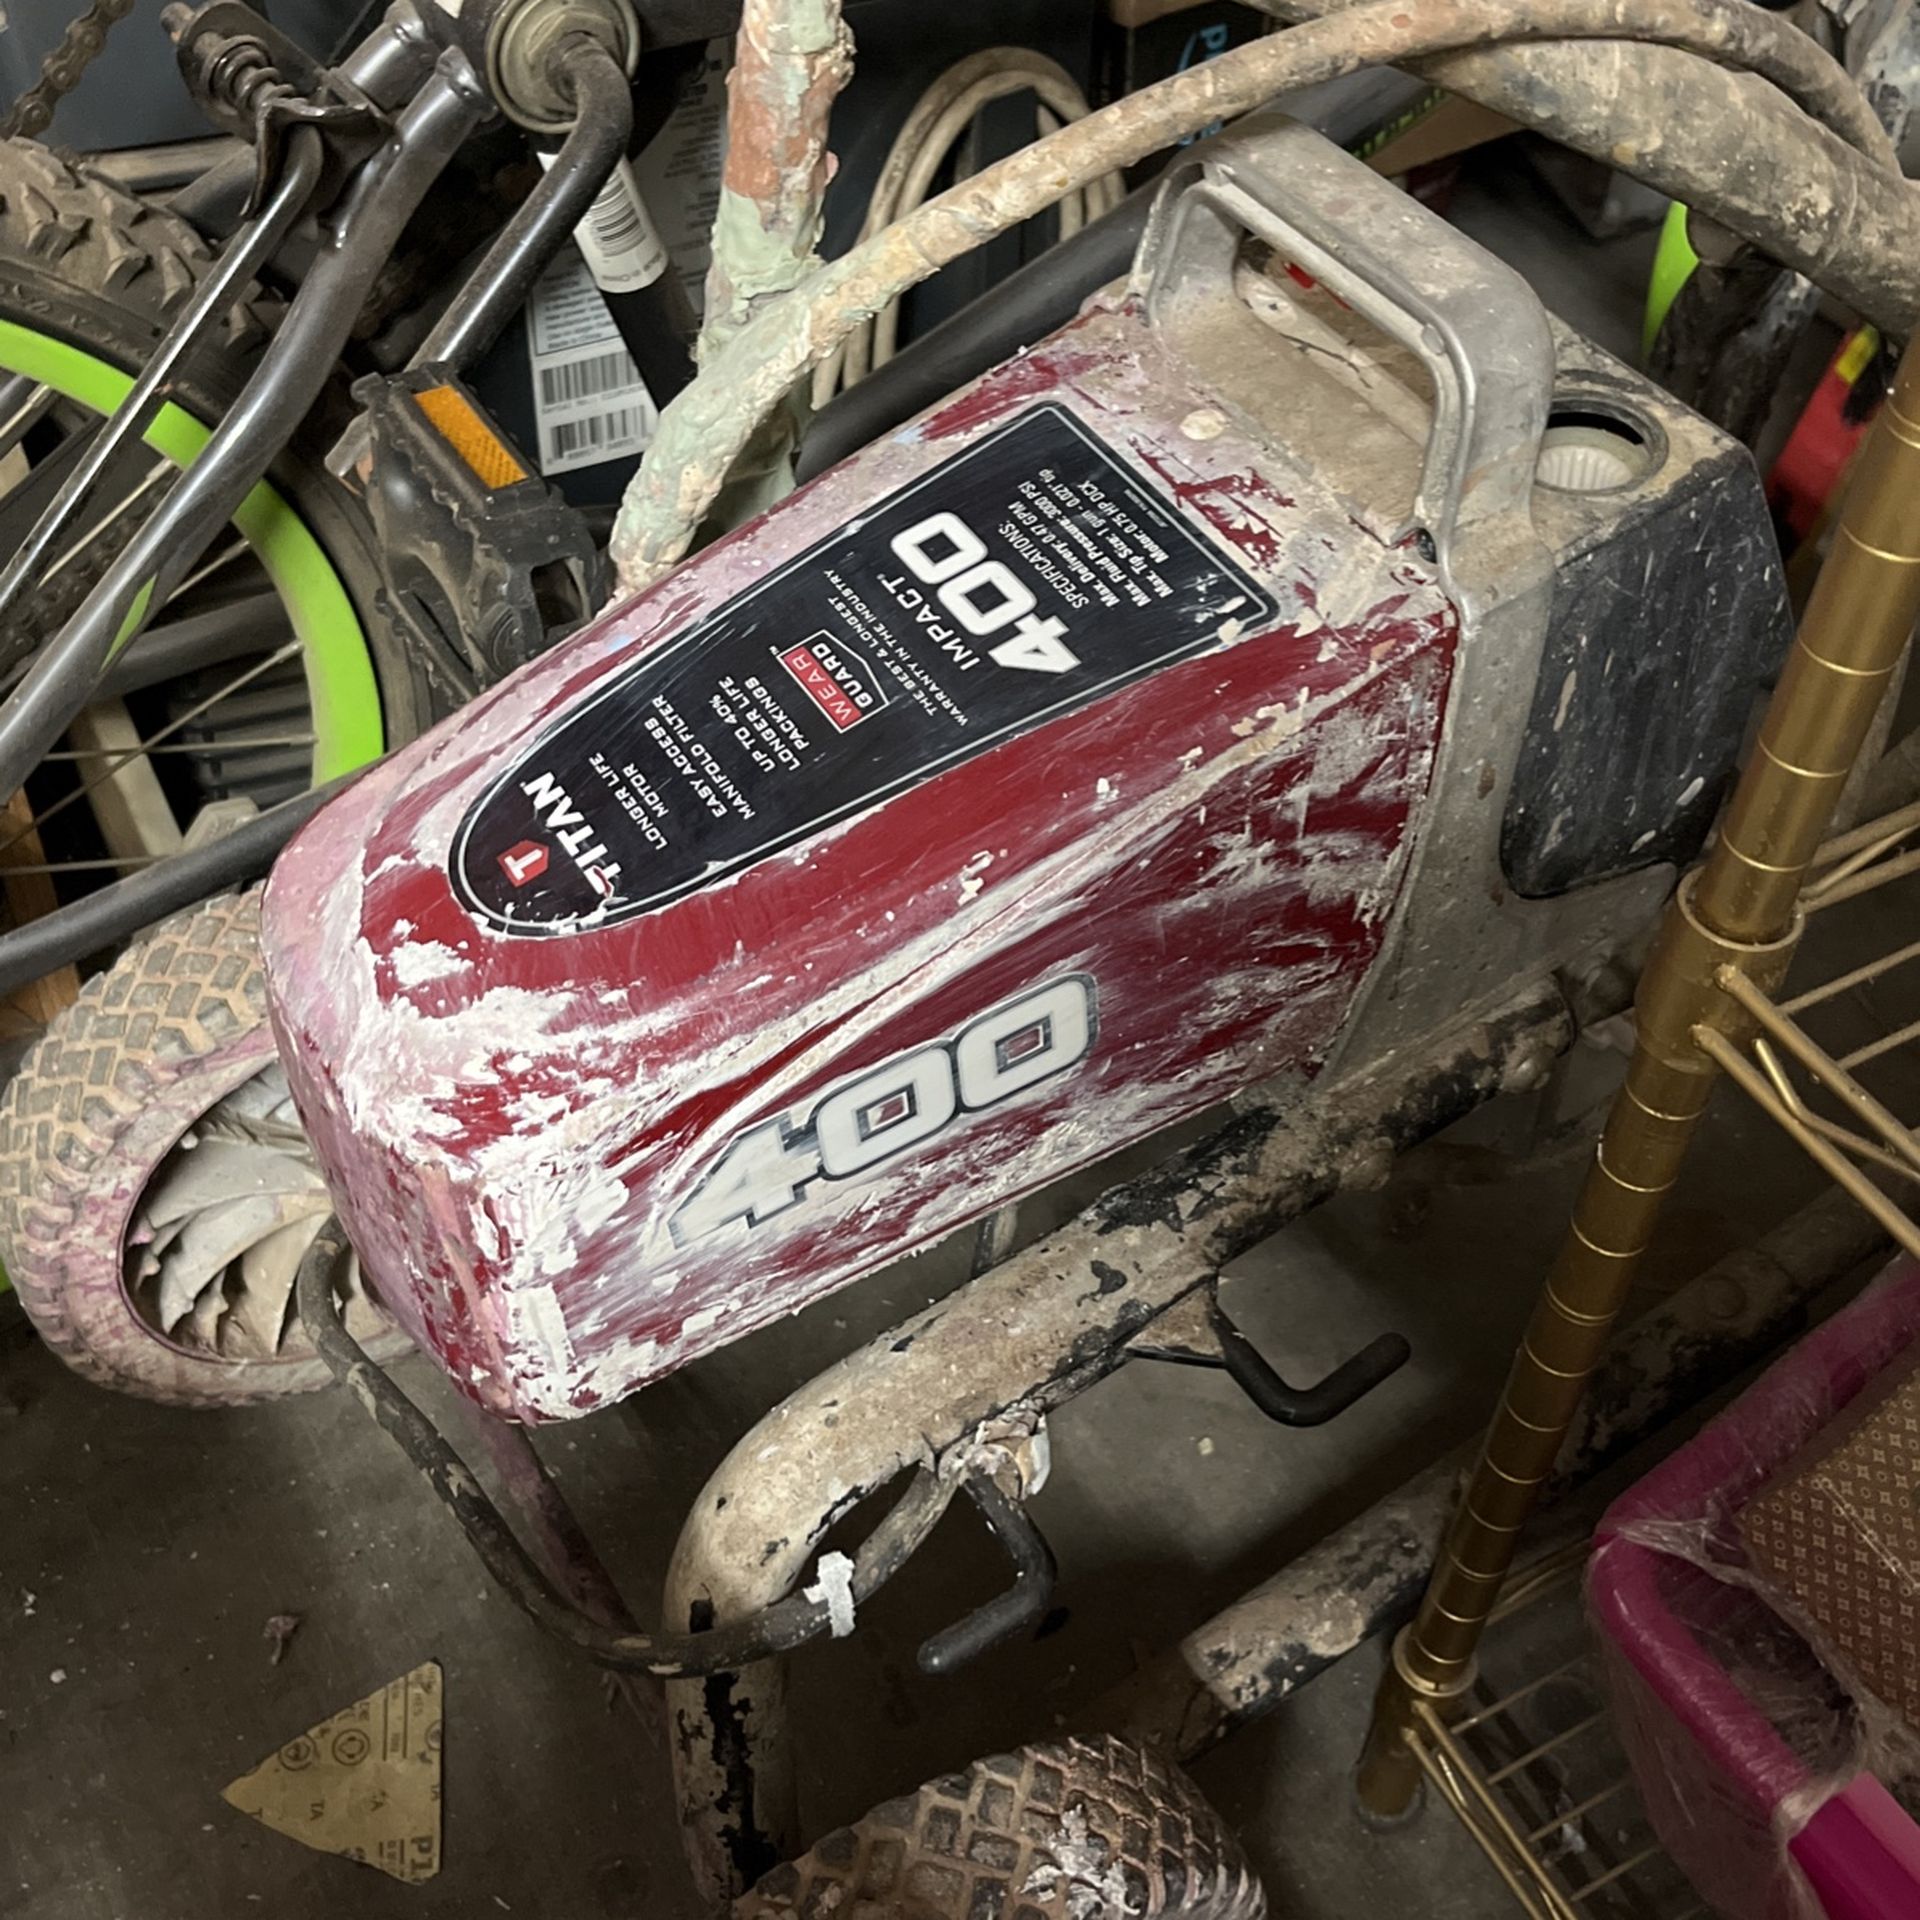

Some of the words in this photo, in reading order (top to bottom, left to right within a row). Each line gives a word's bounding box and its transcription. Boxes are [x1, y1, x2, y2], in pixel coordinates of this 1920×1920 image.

[1017, 480, 1042, 500] PSI
[1077, 480, 1106, 503] DCX
[1007, 501, 1038, 526] GPM
[1078, 509, 1107, 529] gun
[1097, 501, 1120, 516] HP
[1111, 512, 1138, 534] 0.75
[1030, 523, 1057, 544] 0.47
[1056, 515, 1104, 560] Pressure:
[1105, 533, 1133, 559] Size:
[1133, 530, 1169, 564] Motor:
[998, 520, 1090, 609] SPECIFICATIONS:
[1051, 540, 1096, 583] Delivery:
[1094, 556, 1127, 583] Fluid
[1128, 555, 1148, 575] Tip
[823, 569, 877, 624] INDUSTRY
[890, 512, 1081, 673] 400
[1088, 578, 1120, 607] Max.
[1120, 578, 1152, 607] Max.
[1142, 569, 1174, 598] Max.
[827, 597, 879, 648] LONGEST
[873, 622, 897, 648] THE
[881, 576, 980, 671] IMPACT
[876, 647, 889, 658] &
[894, 647, 911, 662] IN
[791, 653, 852, 721] WEAR
[811, 642, 874, 708] GUARD
[883, 660, 916, 690] BEST
[709, 694, 738, 724] 40%
[718, 676, 751, 709] LIFE
[907, 662, 969, 726] WARRANTY
[912, 689, 938, 716] THE
[651, 694, 695, 743] FILTER
[744, 676, 810, 750] PACKINGS
[644, 717, 697, 775] ACCESS
[734, 726, 756, 750] TO
[745, 708, 801, 771] LONGER
[588, 752, 620, 787] LIFE
[751, 750, 776, 773] UP
[622, 763, 669, 818] MOTOR
[689, 778, 728, 818] EASY
[690, 743, 756, 820] MANIFOLD
[522, 771, 622, 897] TITAN
[614, 786, 668, 850] LONGER
[667, 973, 1100, 1248] 400
